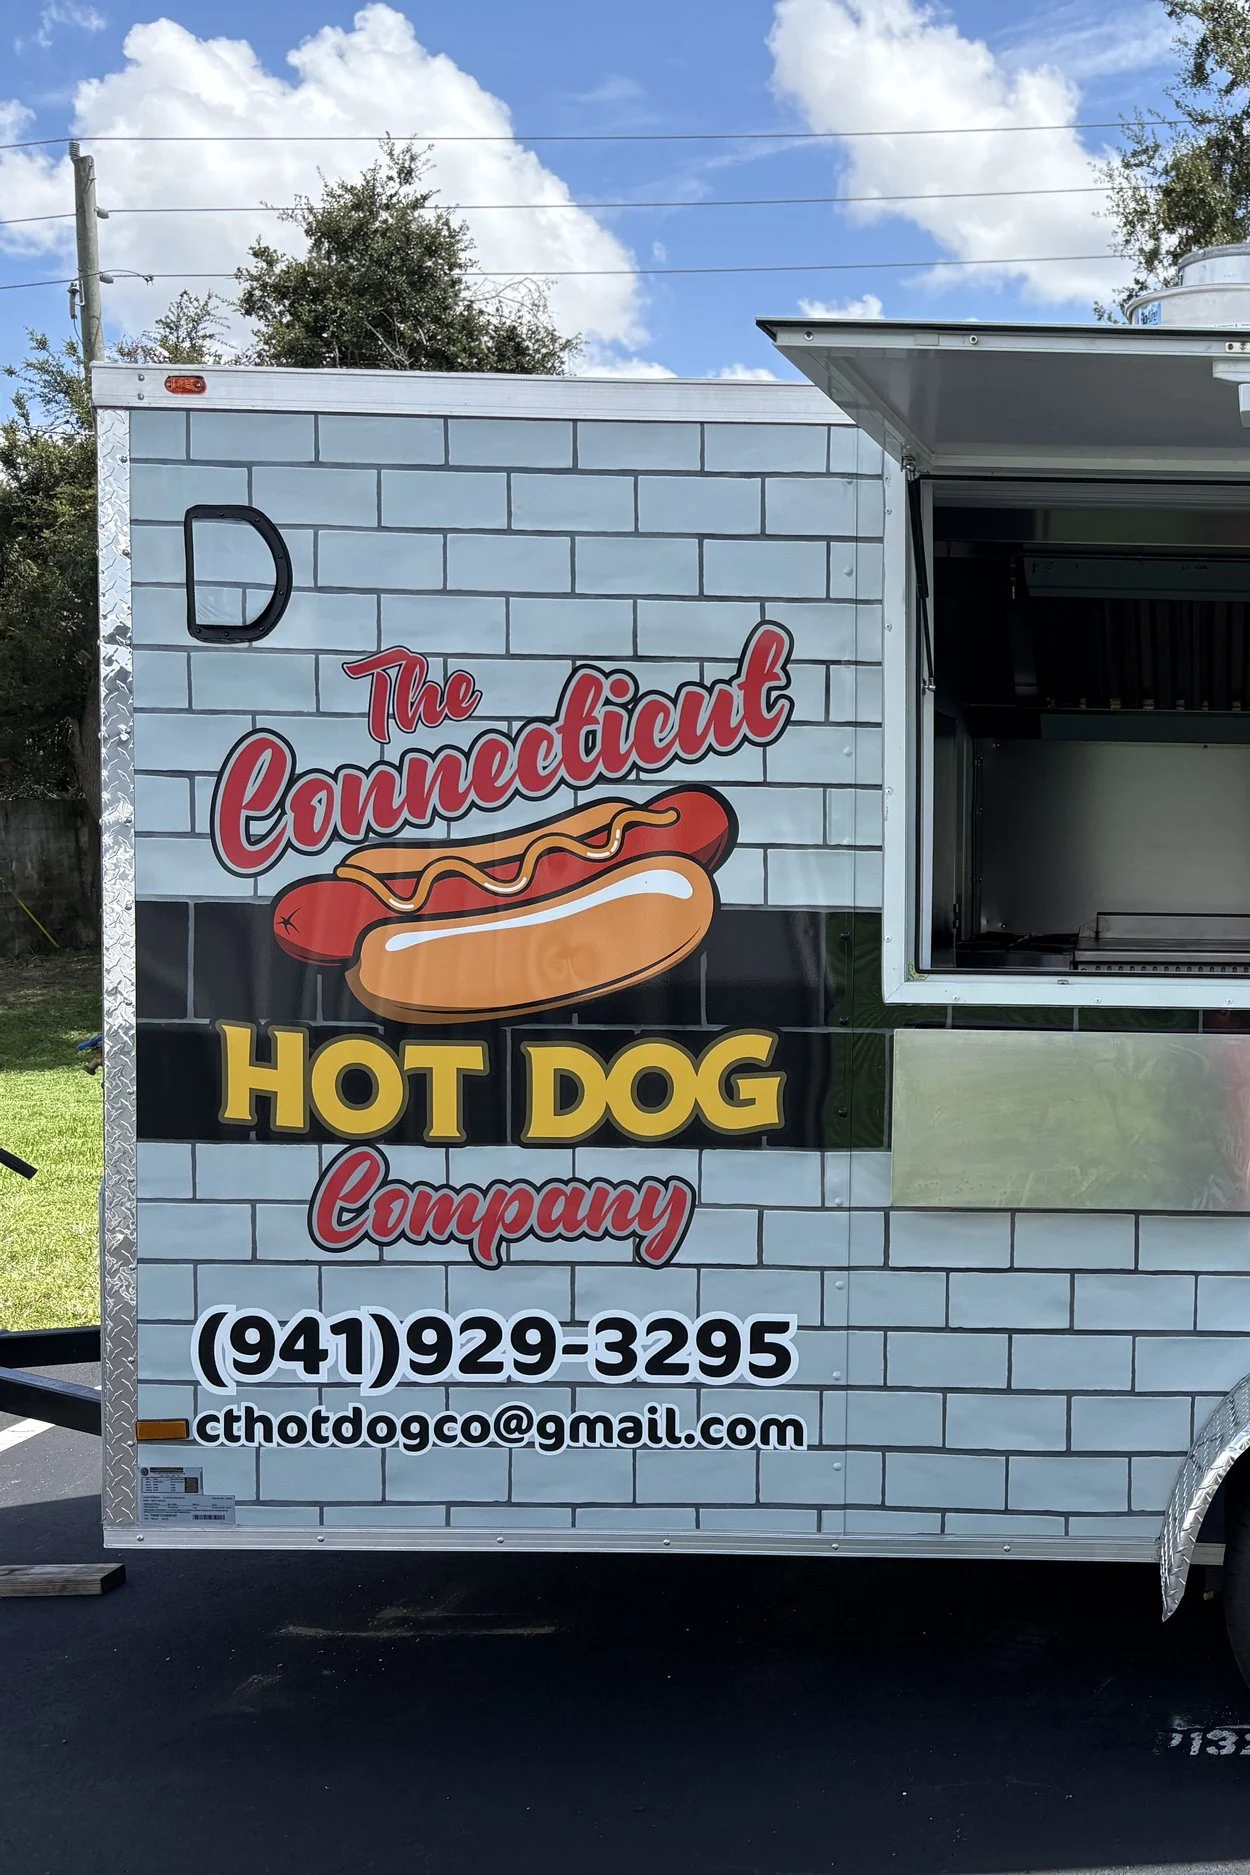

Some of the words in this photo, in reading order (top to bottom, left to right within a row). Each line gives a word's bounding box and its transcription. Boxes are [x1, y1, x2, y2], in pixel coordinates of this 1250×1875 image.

[210, 620, 794, 877] Connecticut
[343, 645, 483, 744] The
[217, 1020, 489, 1142] HOT
[520, 1030, 786, 1141] DOG
[307, 1145, 696, 1269] Company
[195, 1308, 797, 1392] (941)929-3295
[196, 1403, 806, 1453] cthotdogco@gmail.com
